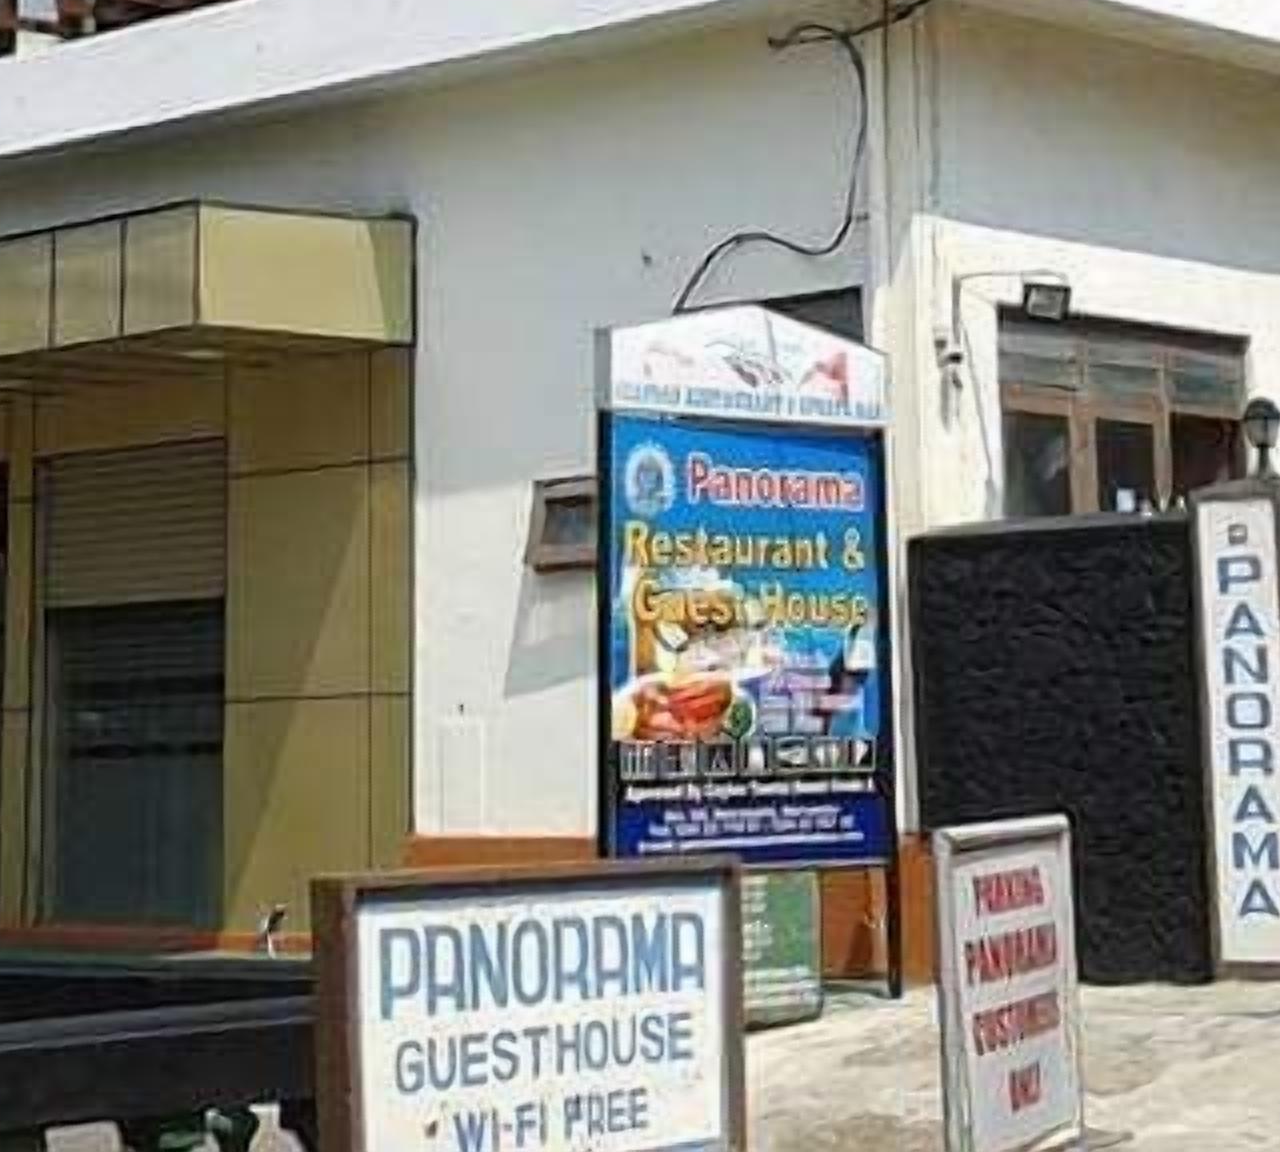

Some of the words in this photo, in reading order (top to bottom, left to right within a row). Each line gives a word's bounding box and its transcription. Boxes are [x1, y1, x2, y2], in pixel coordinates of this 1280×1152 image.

[687, 451, 865, 512] Panorama
[624, 520, 829, 570] Restaurant
[843, 526, 866, 569] &
[760, 583, 869, 626] House
[1217, 555, 1280, 919] PANORAMA
[379, 912, 705, 1020] PANORAMA
[452, 1095, 548, 1152] WI-FI
